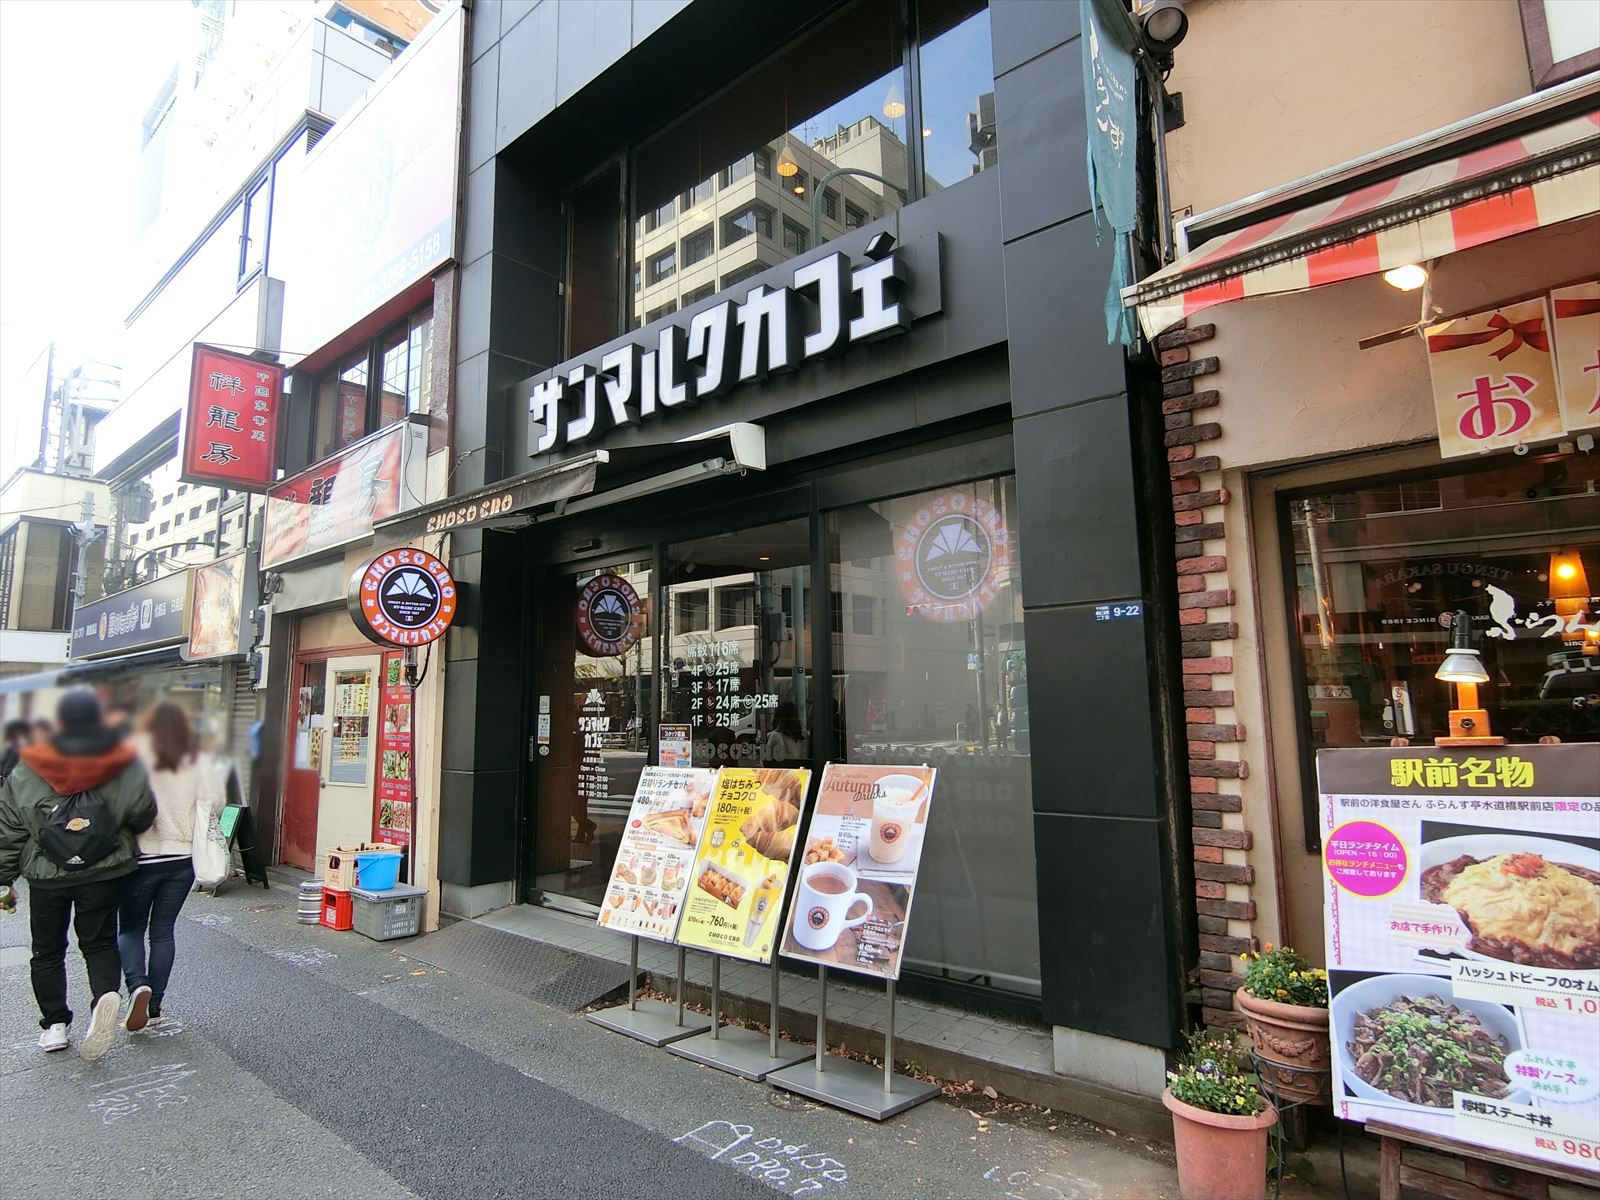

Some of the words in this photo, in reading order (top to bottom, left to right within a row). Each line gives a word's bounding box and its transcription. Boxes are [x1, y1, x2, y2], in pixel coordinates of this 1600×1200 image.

[529, 250, 901, 452] サンマルクカフェ
[1456, 376, 1536, 440] お
[200, 371, 246, 465] 祥龍房
[427, 504, 477, 533] CHOCO
[364, 550, 426, 591] CHOCO
[1113, 605, 1140, 617] 9-22
[371, 613, 448, 644] サンマルクカフェ
[691, 664, 703, 676] 4F
[715, 661, 740, 676] 25席
[691, 681, 703, 694] 3F
[715, 677, 741, 693] 17席
[691, 697, 703, 709] 2F
[715, 695, 741, 710] 24席
[754, 694, 779, 709] 25席
[578, 716, 610, 732] サンマルク
[691, 715, 703, 727] 1F
[715, 712, 741, 727] 25席
[584, 732, 603, 748] カフェ
[1390, 756, 1535, 788] 駅前名物
[721, 779, 762, 789] 塩はちみつ
[826, 778, 881, 793] Autumn
[719, 791, 757, 801] チョコクロ
[852, 790, 887, 802] Drinks
[1340, 798, 1422, 809] 駅前の洋食屋さん
[1330, 841, 1400, 852] 平日ランチタイム
[1328, 859, 1405, 871] お得なランチメニューも
[1336, 868, 1398, 878] ご用意しております
[708, 931, 728, 940] CHOCO
[1535, 996, 1558, 1009] 税込
[1461, 1098, 1553, 1128] 檸檬ステーキ丼
[1535, 1136, 1558, 1152] 税込
